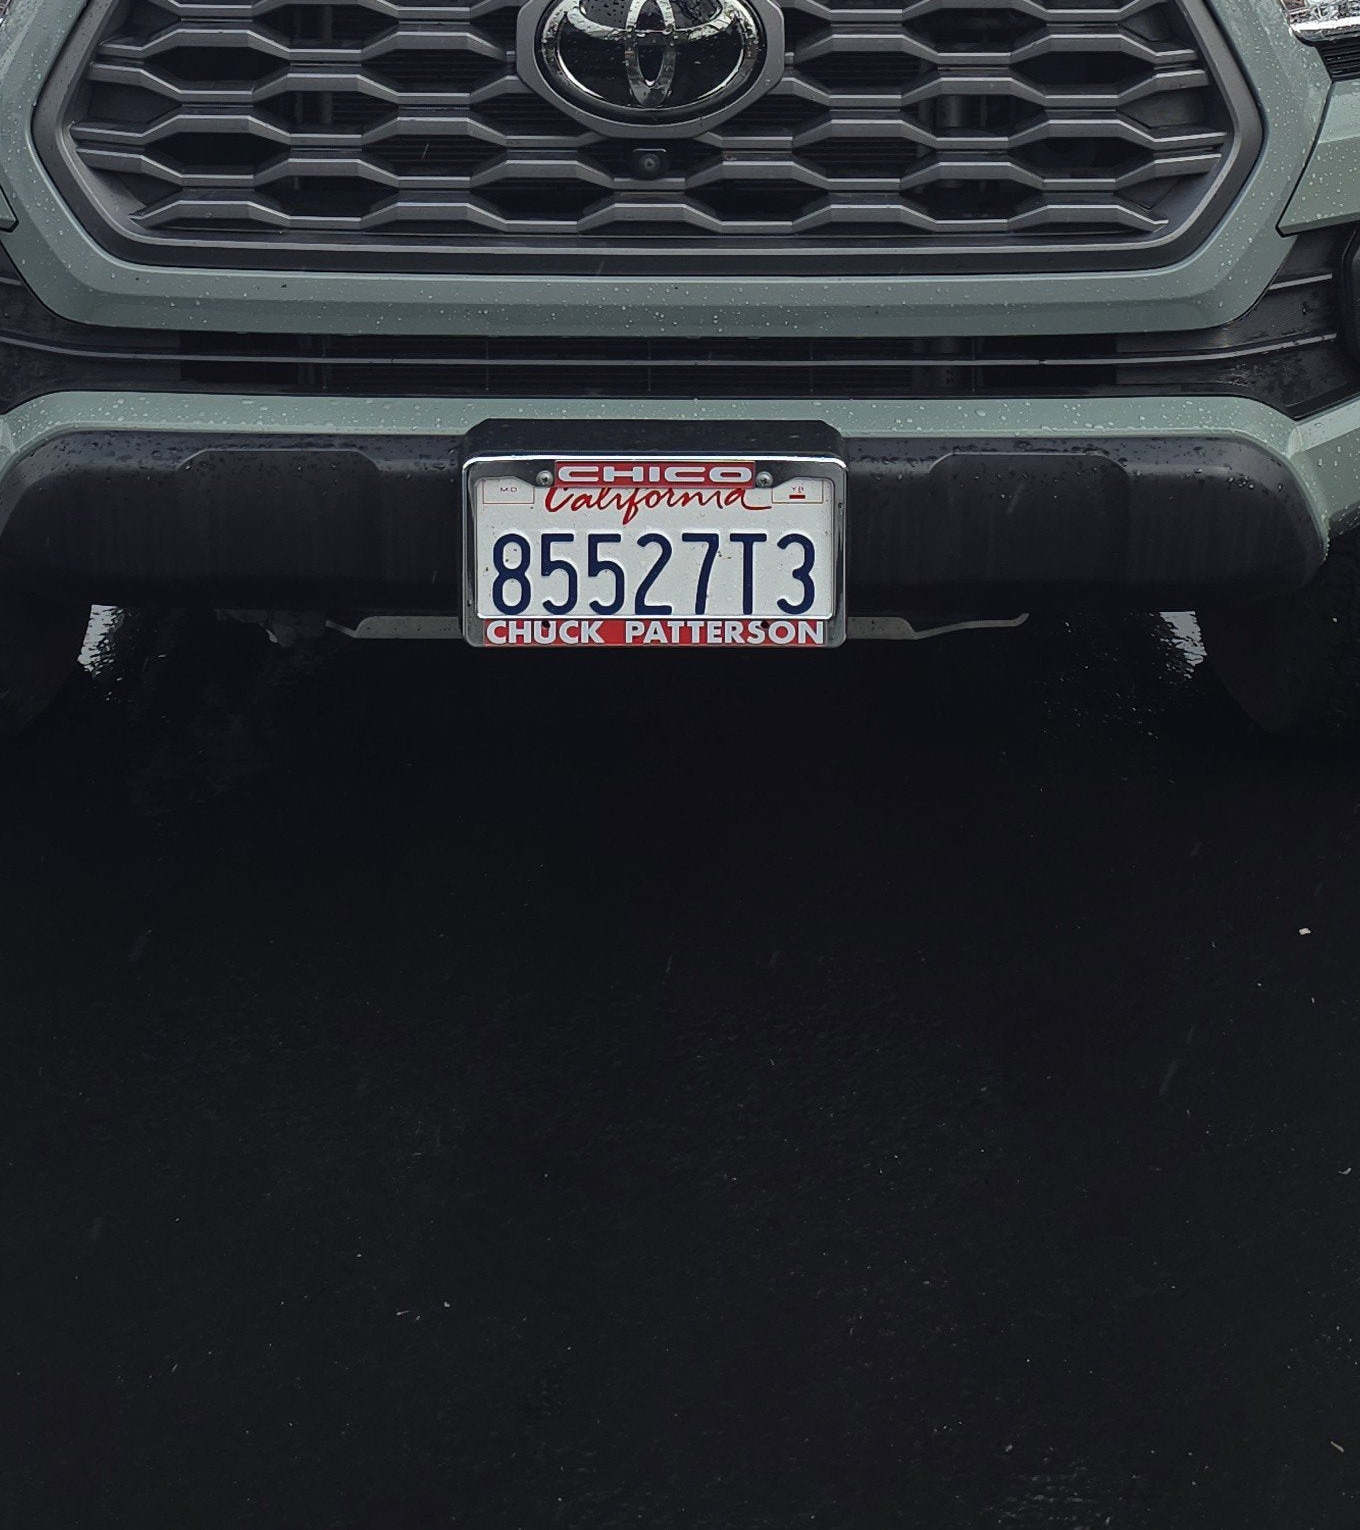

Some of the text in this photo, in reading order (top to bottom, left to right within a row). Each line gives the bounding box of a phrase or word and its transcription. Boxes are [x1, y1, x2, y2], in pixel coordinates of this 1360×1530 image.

[557, 465, 753, 483] CHICO
[544, 486, 772, 525] California
[491, 532, 816, 616] 85527T3
[485, 619, 825, 645] CHUCK PATTERSON
